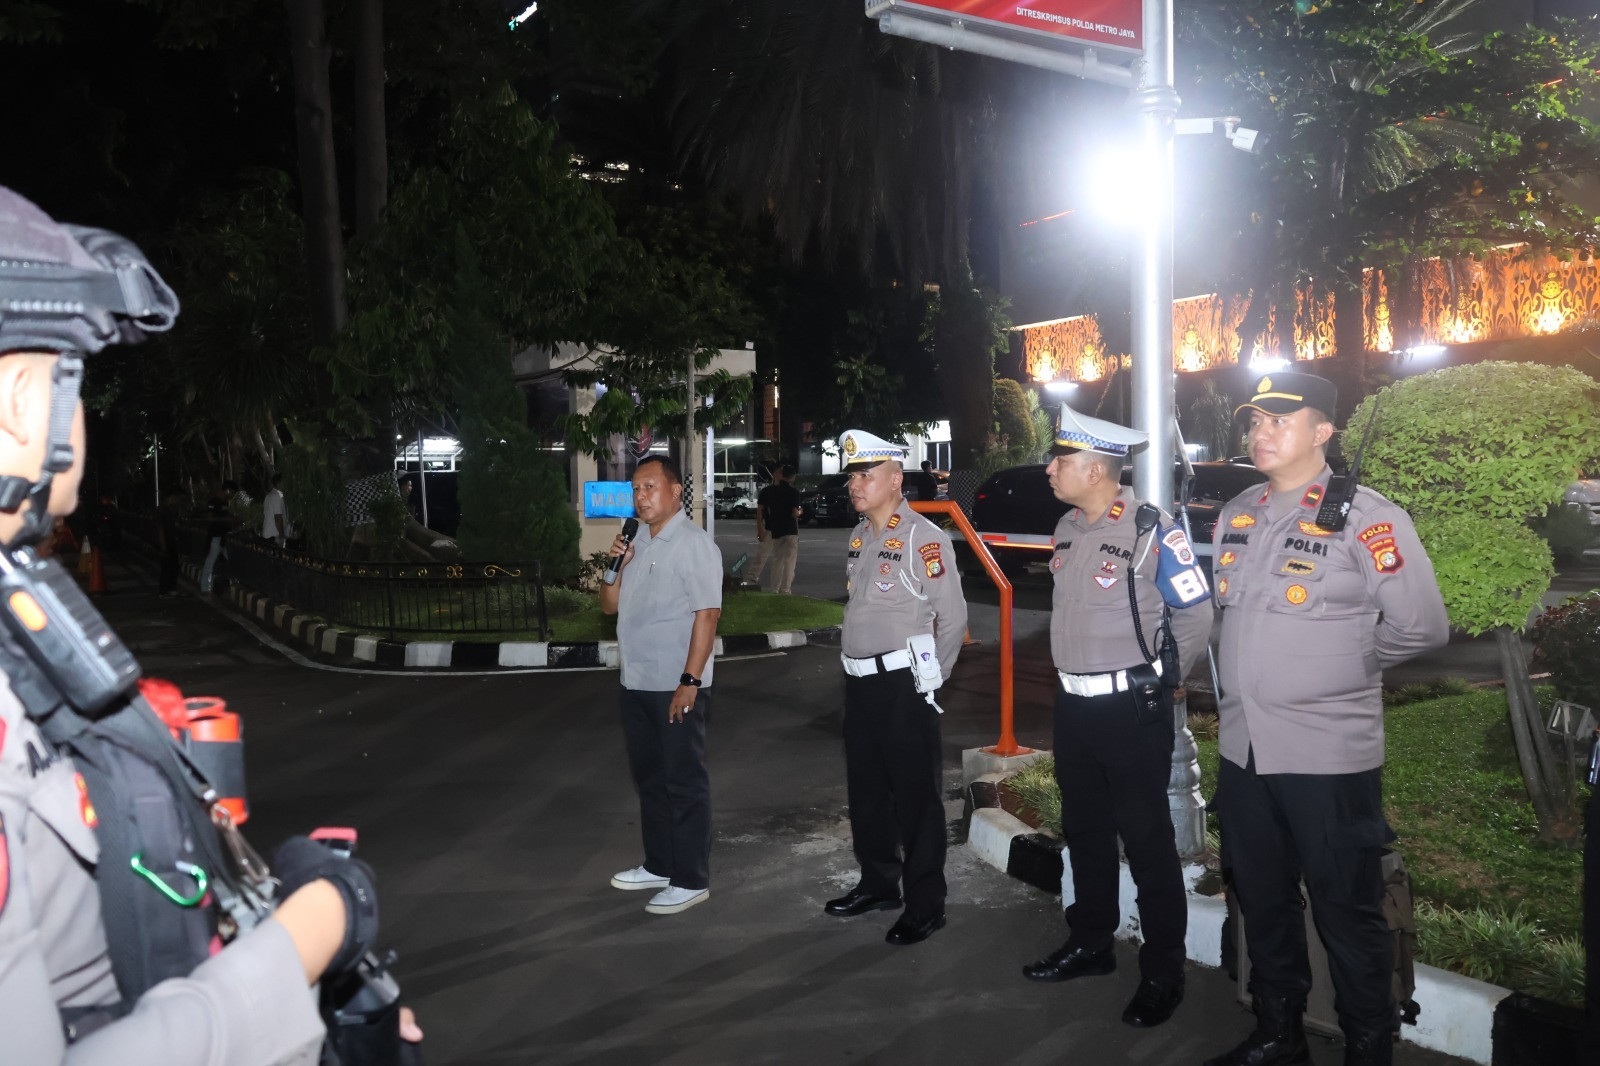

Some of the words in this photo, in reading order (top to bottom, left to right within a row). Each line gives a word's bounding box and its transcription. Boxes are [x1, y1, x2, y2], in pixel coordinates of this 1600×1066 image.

[1016, 6, 1071, 26] DITRESKRIMSUS
[1072, 18, 1094, 31] POLDA
[1095, 23, 1118, 36] METRO
[1118, 28, 1136, 39] JAYA
[1361, 525, 1390, 541] POLDA
[920, 543, 939, 554] POLDA
[1284, 537, 1328, 557] POLRI
[877, 551, 903, 562] POLRI
